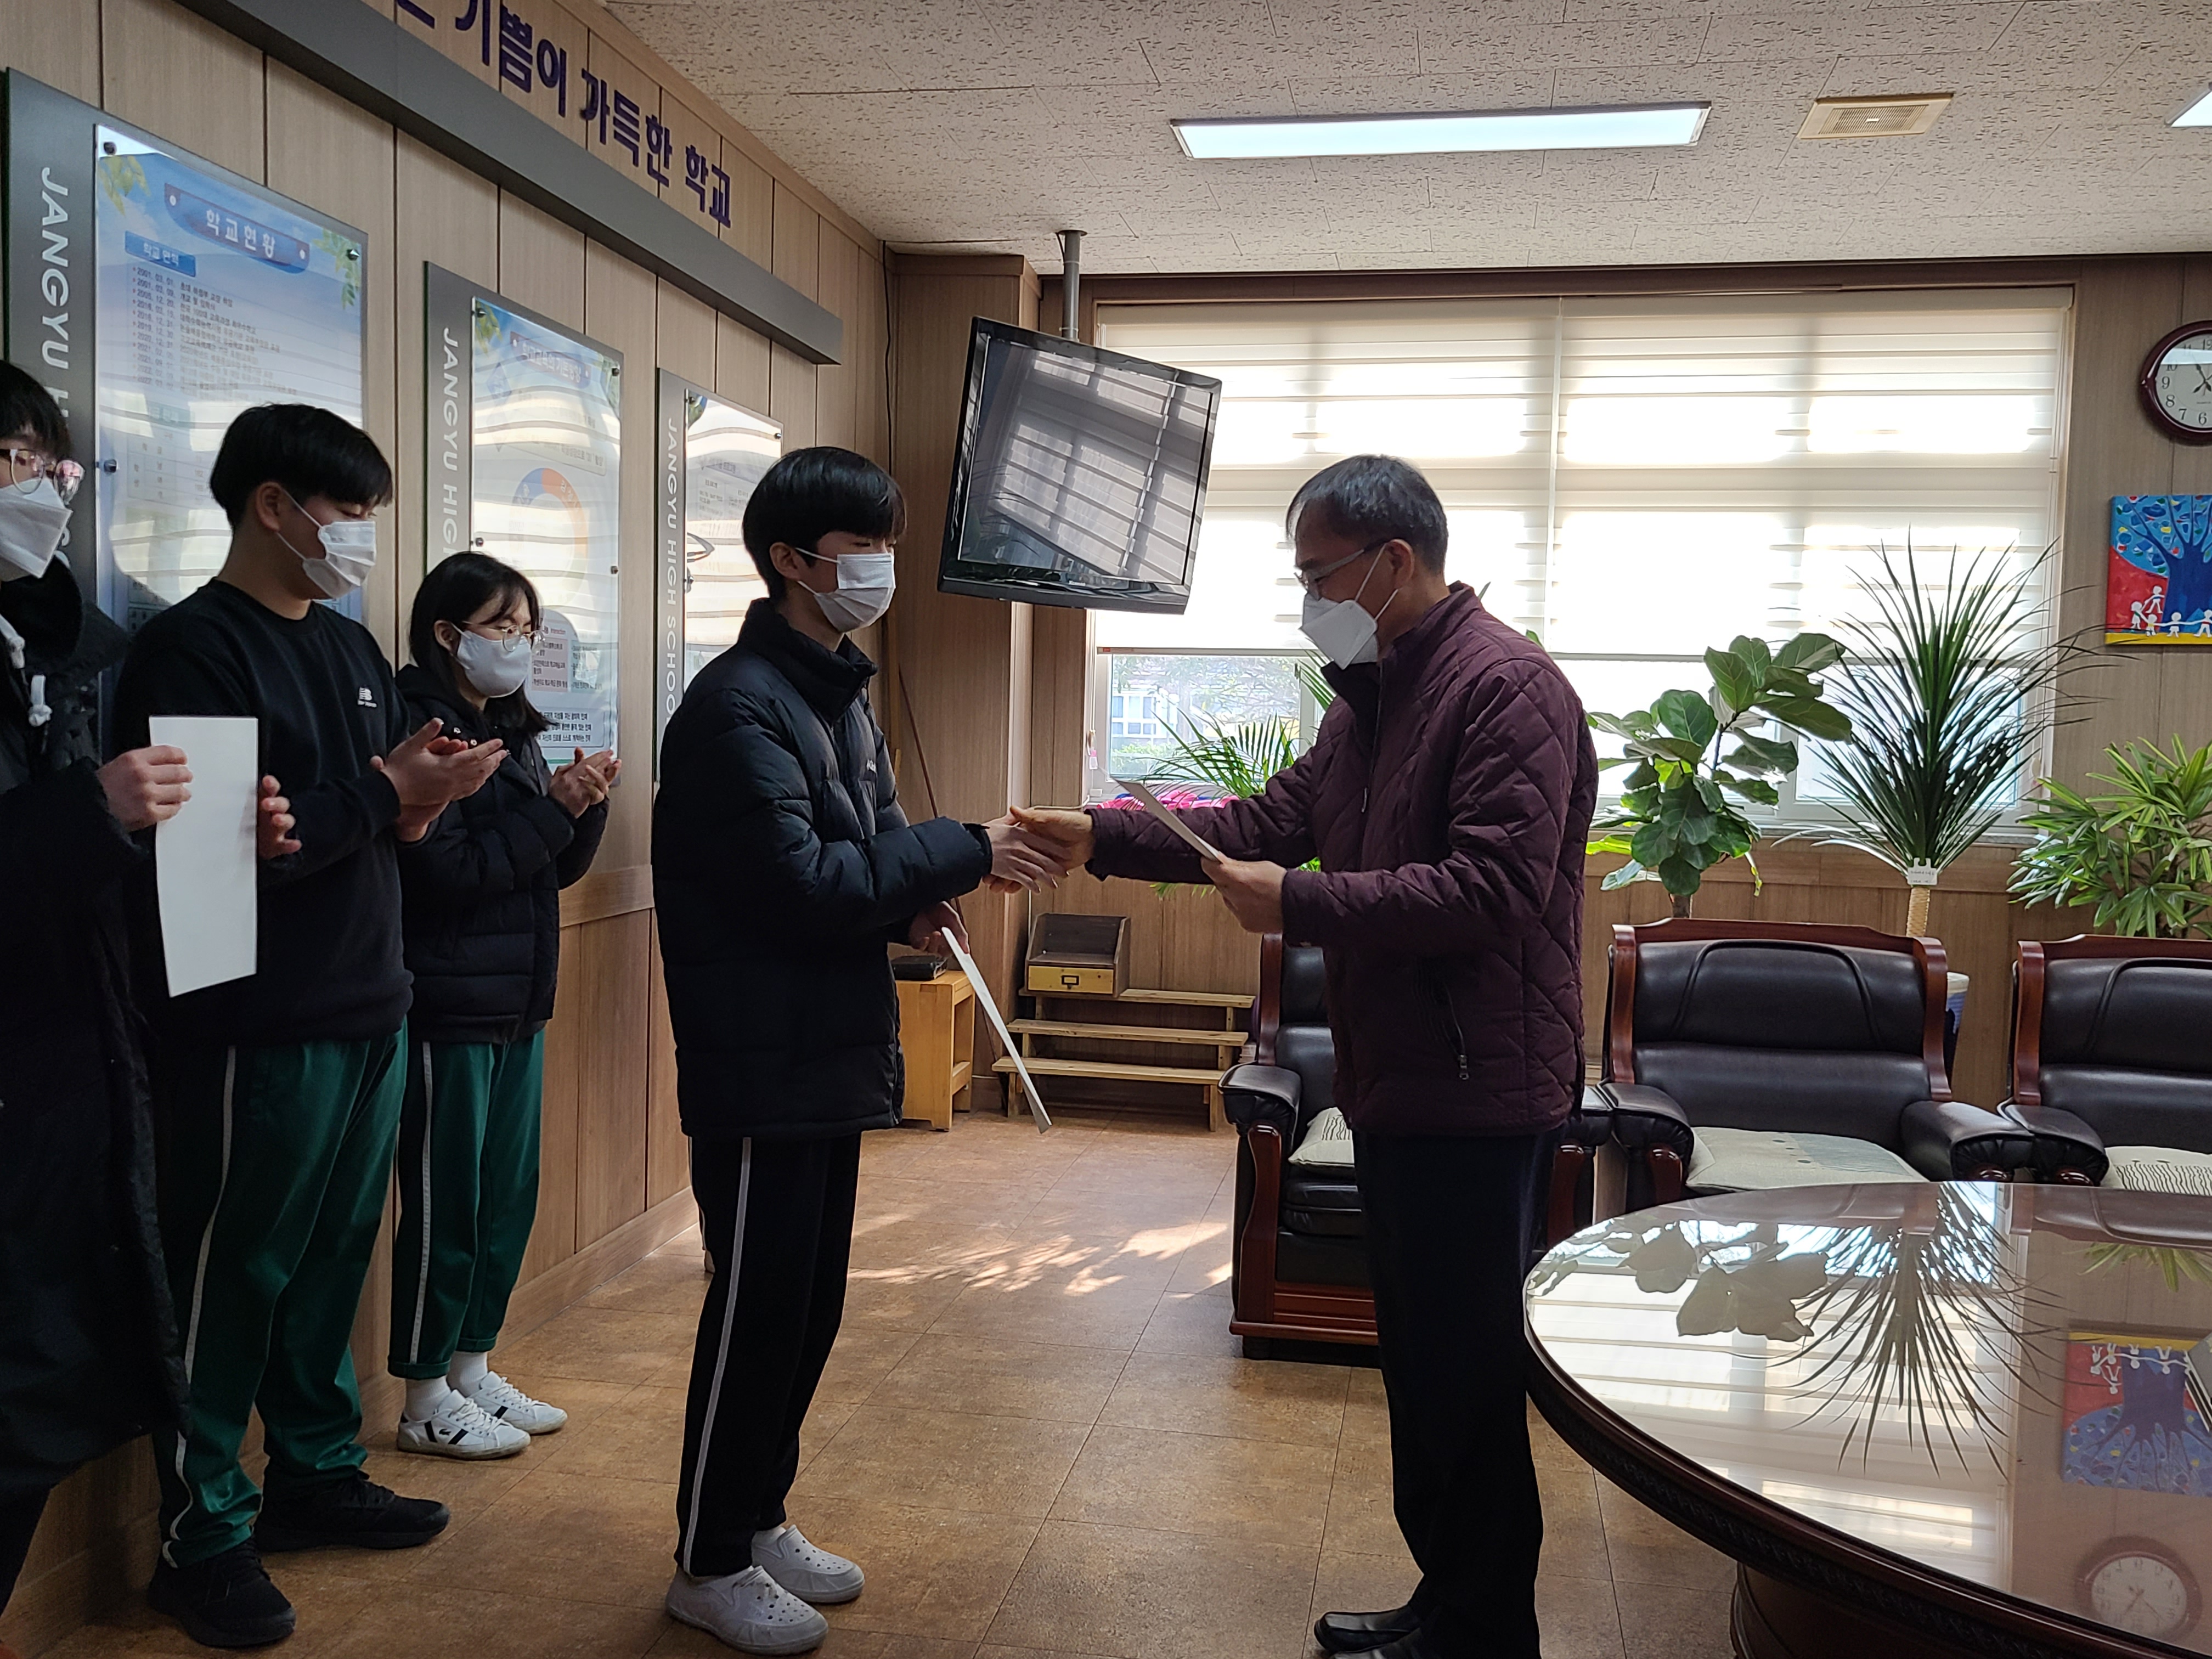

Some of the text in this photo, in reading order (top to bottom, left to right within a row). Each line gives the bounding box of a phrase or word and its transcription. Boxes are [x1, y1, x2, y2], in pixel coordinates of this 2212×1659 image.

[455, 0, 731, 228] 기쁨이 가득한 학교
[206, 209, 275, 258] 학교현황
[42, 167, 69, 369] JANGYU
[443, 327, 458, 471] JANGYU
[2162, 376, 2170, 390] 9
[2166, 394, 2175, 408] 8
[2179, 408, 2187, 420] 7
[2198, 413, 2207, 426] 6
[668, 417, 678, 529] JANGYU
[668, 540, 677, 605] HIGH
